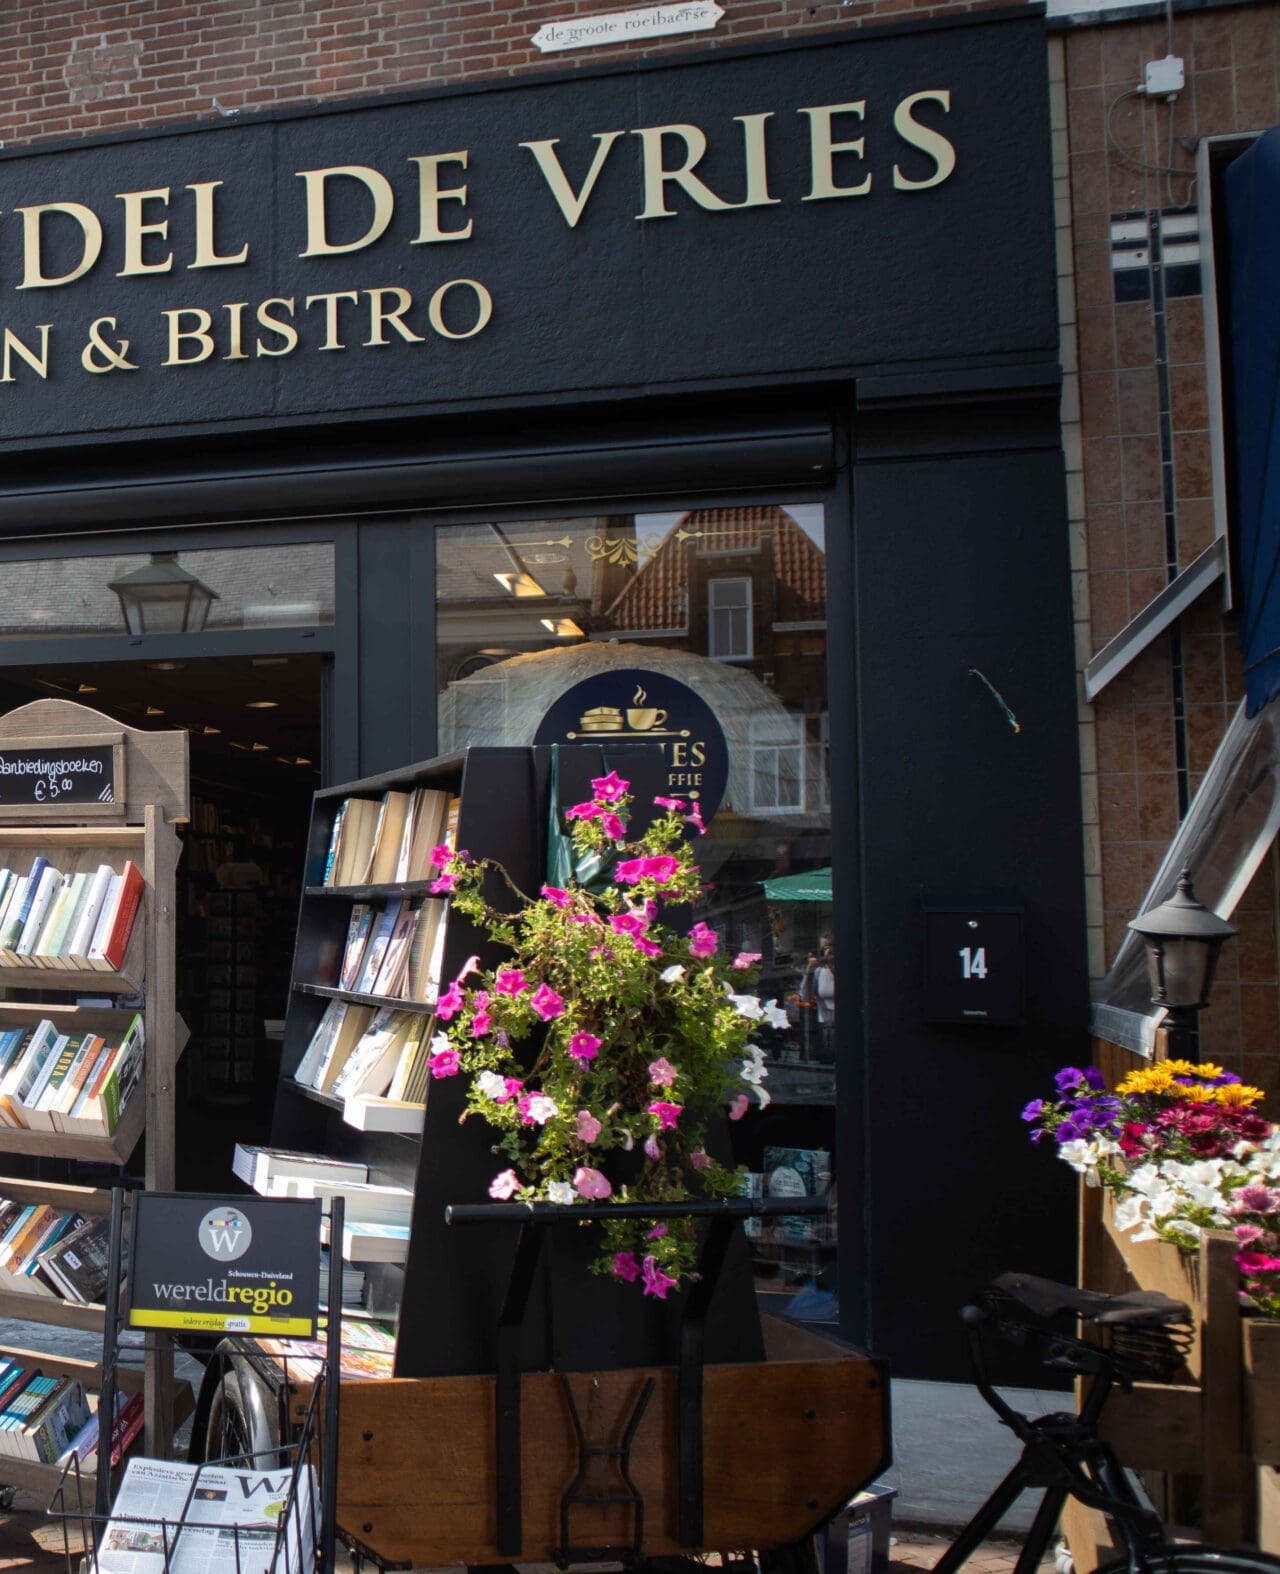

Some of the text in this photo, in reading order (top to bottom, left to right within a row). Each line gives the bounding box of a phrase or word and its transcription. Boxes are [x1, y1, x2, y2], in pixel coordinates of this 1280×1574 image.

[545, 27, 563, 42] de
[295, 150, 474, 259] DE
[519, 90, 956, 228] VRIES
[81, 316, 140, 373] &
[161, 279, 493, 366] BISTRO
[668, 773, 703, 786] FFIE
[959, 947, 988, 978] 14
[52, 1051, 75, 1077] NORA
[228, 1269, 293, 1280] Schouwen-Duiveland
[153, 1278, 293, 1314] wereldregio
[227, 1318, 246, 1329] gratis
